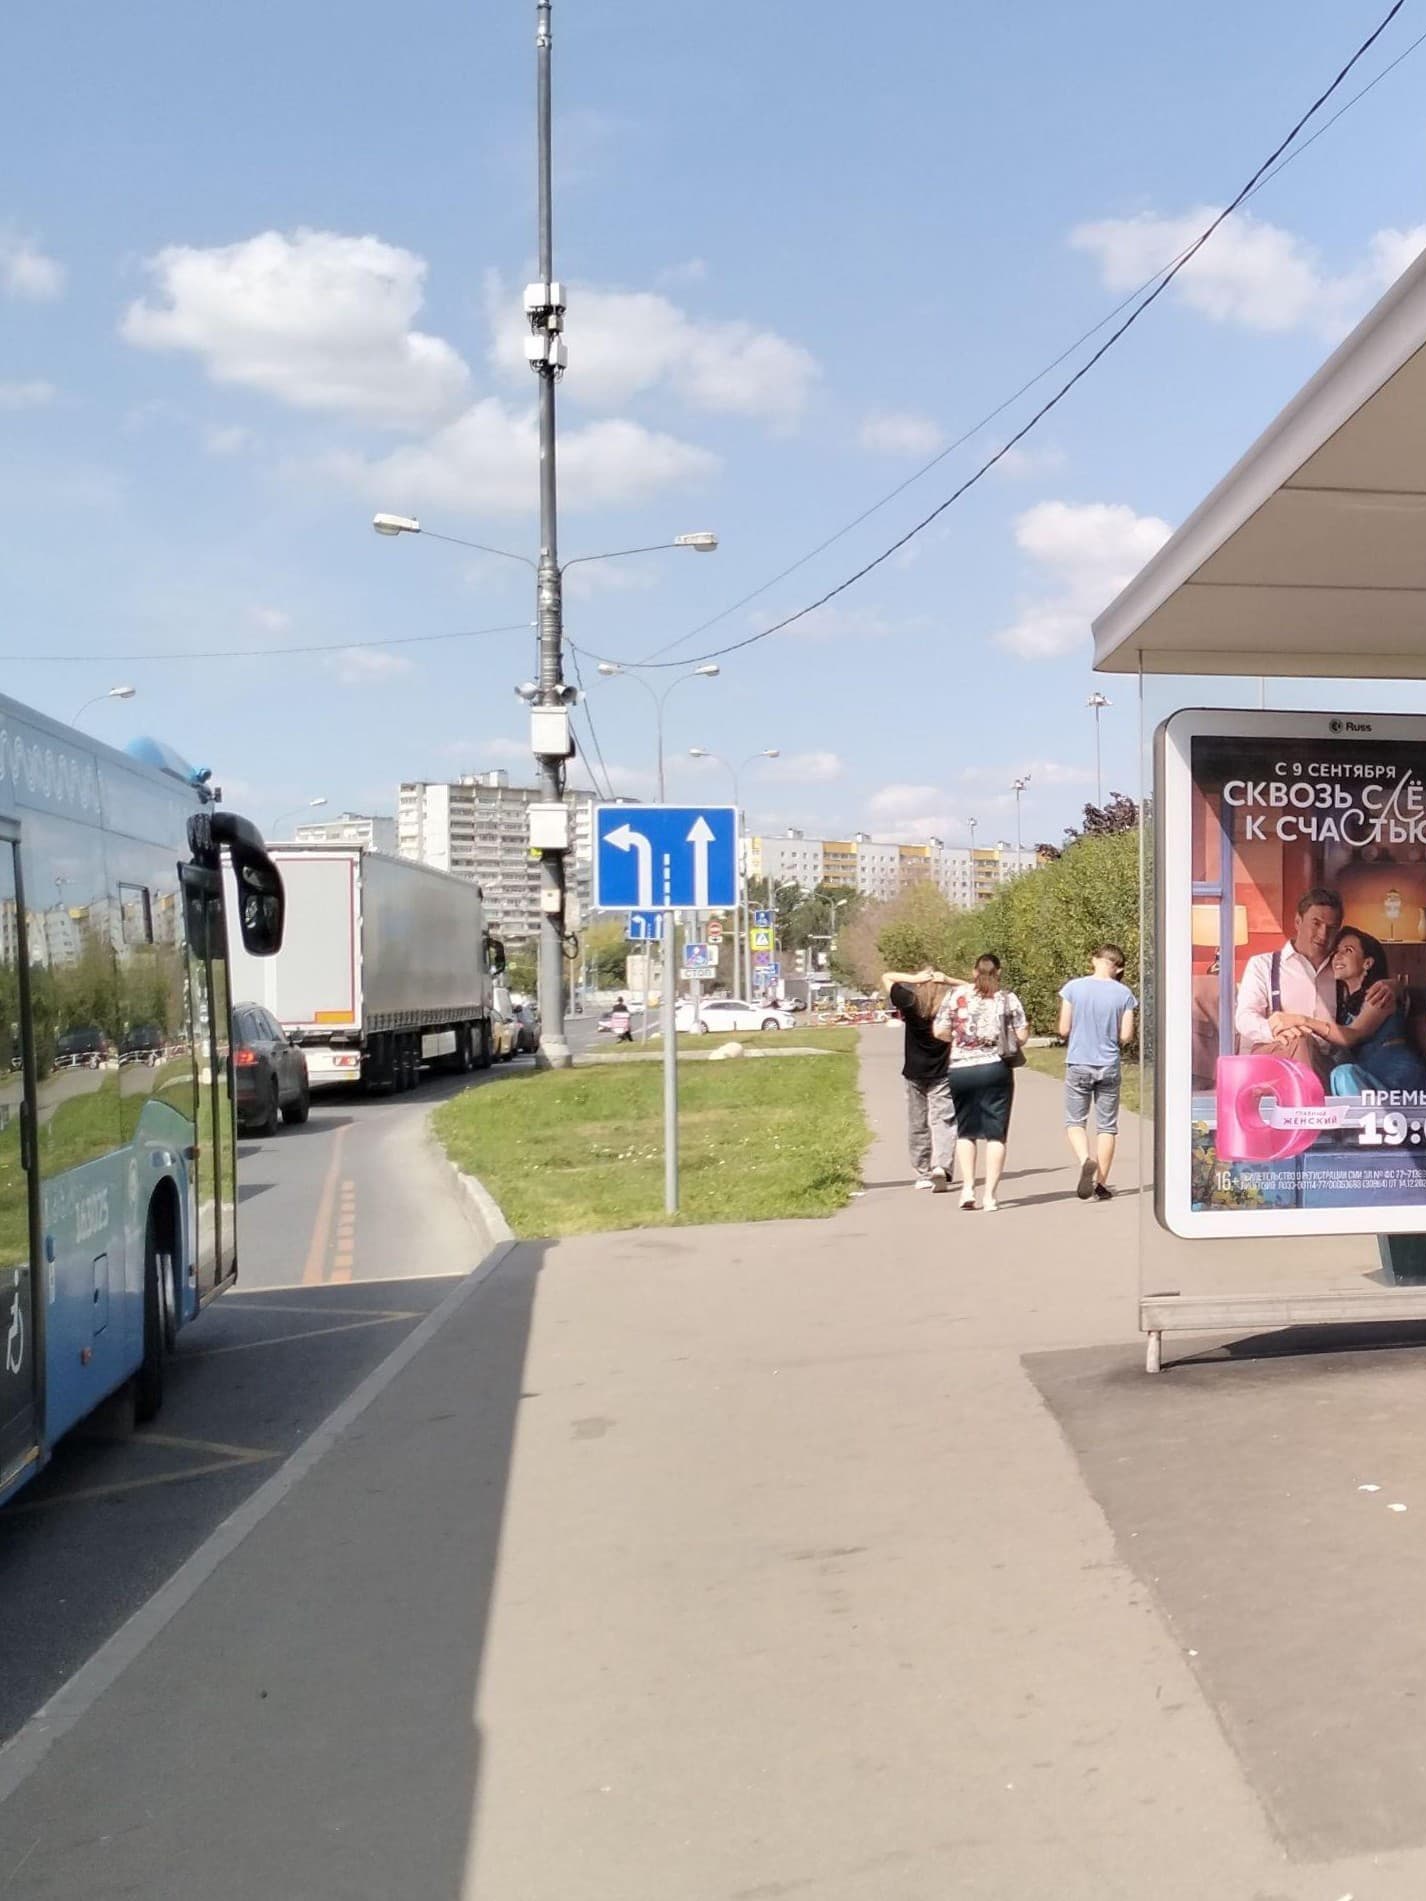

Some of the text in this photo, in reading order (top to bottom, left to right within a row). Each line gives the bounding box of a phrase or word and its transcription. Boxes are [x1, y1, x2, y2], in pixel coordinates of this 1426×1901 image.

[1345, 721, 1372, 732] Russ
[1275, 762, 1396, 779] С 9 СЕНТЯБРЯ
[1223, 780, 1352, 809] СКВОЗЬ
[1246, 815, 1266, 840] К
[1283, 1116, 1337, 1126] ЖЕНСКИЙ
[1215, 1171, 1240, 1191] 16+
